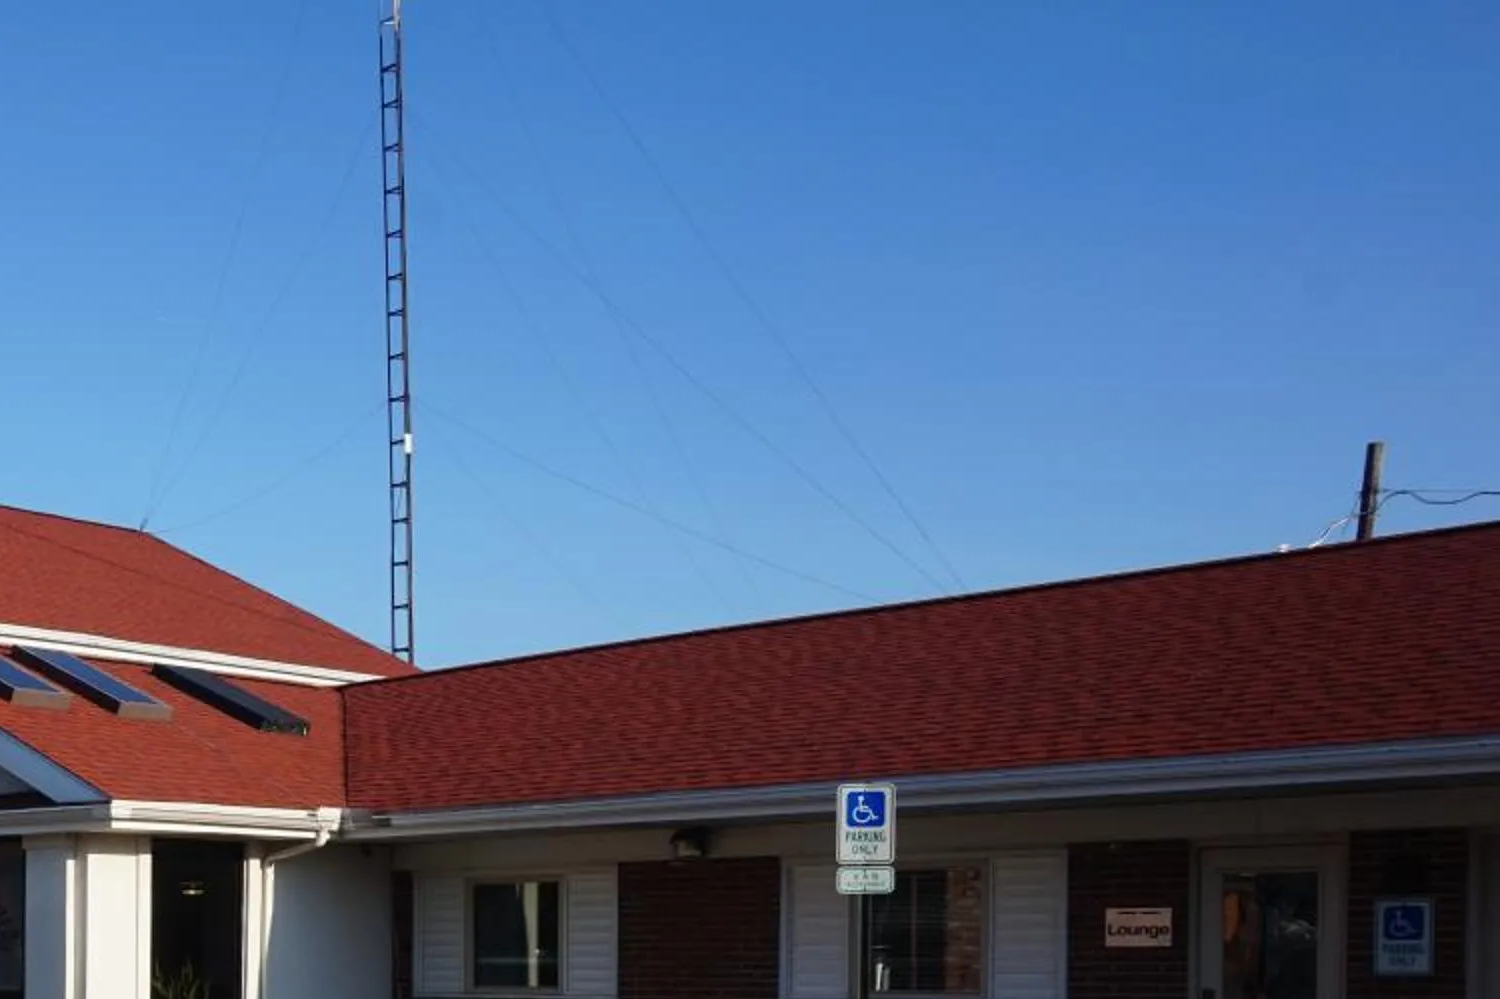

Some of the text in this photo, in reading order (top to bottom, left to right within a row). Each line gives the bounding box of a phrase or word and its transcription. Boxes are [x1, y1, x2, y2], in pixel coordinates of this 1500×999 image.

[845, 831, 887, 843] PARKING
[851, 845, 879, 855] ONLY
[1108, 923, 1169, 939] Lounge
